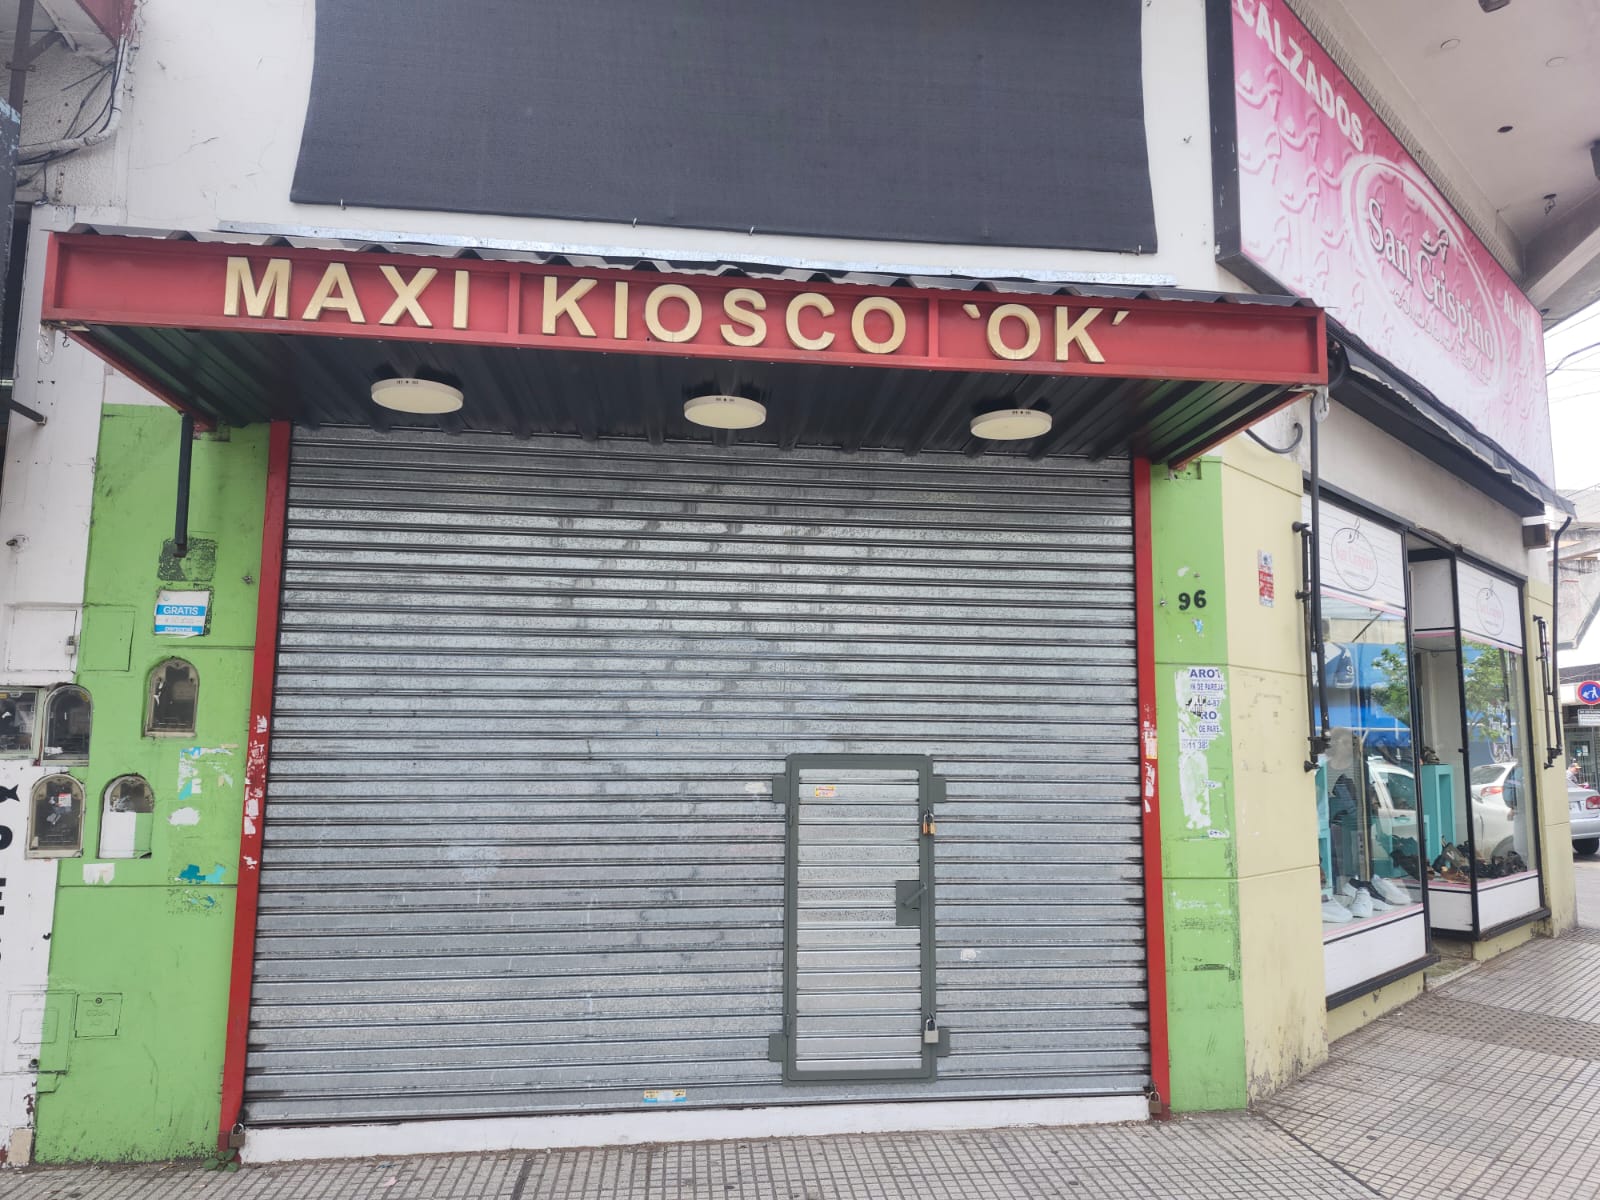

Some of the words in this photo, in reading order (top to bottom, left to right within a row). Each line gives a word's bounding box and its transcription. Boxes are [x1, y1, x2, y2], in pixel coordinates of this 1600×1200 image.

[1237, 0, 1365, 153] CALZADOS
[223, 256, 470, 330] MAXI
[541, 275, 907, 355] KIOSCO
[1367, 198, 1413, 283] San
[1416, 249, 1496, 362] Crispino
[163, 606, 199, 615] GRATIS
[1178, 589, 1207, 611] 96
